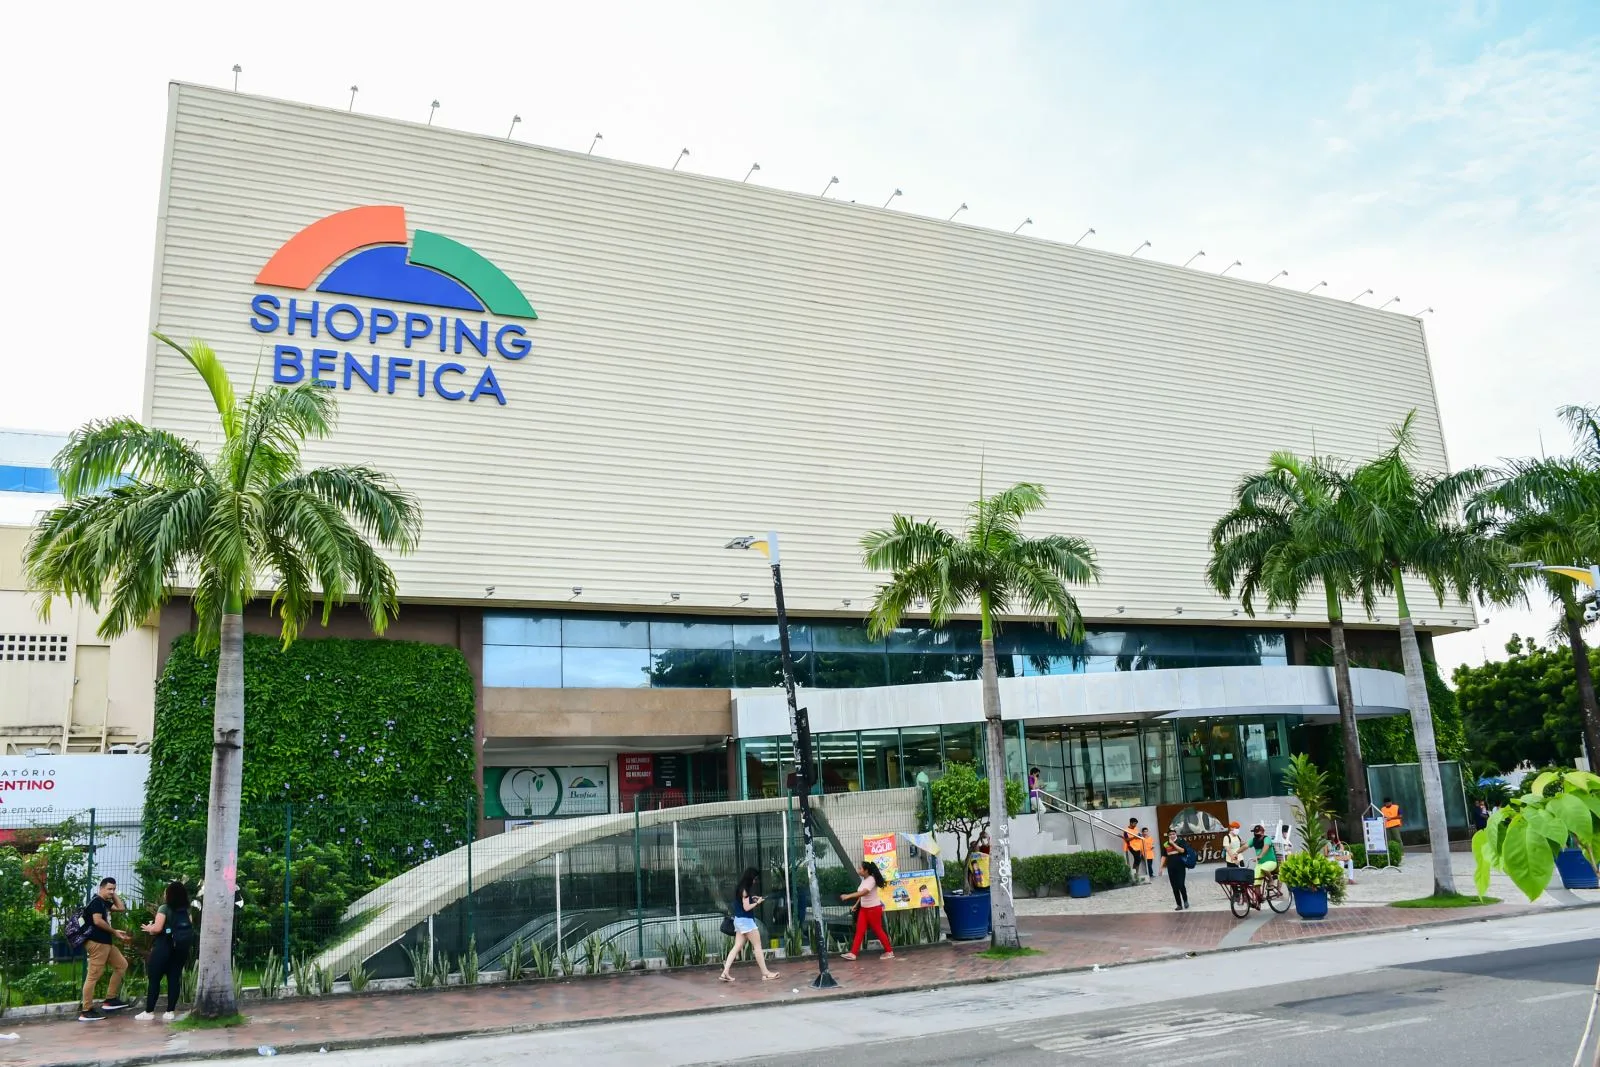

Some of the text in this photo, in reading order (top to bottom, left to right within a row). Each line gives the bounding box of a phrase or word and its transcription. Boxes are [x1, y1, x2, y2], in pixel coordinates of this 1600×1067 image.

[249, 294, 533, 360] SHOPPING
[273, 344, 507, 405] BENFICA
[570, 790, 597, 799] Benfica
